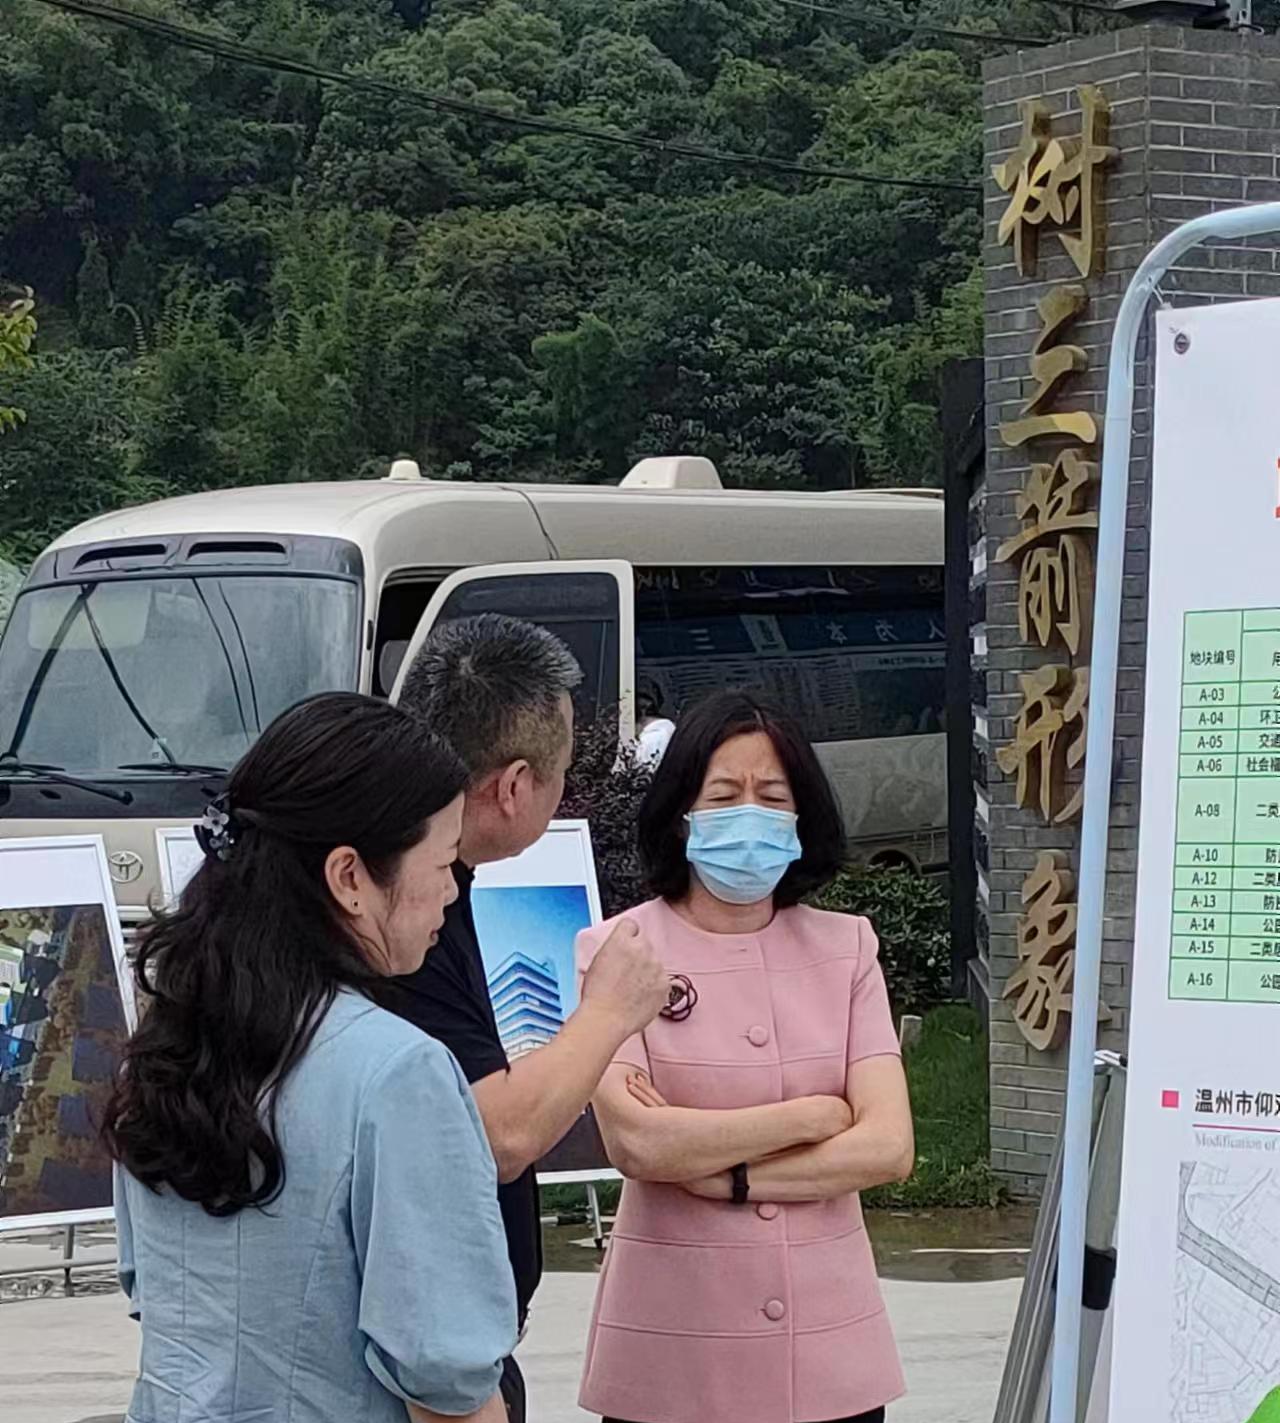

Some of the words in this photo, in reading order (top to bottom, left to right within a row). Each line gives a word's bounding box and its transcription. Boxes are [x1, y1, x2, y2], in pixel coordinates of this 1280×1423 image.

[1190, 650, 1236, 666] 地块编号
[1199, 687, 1225, 702] A-03
[1198, 711, 1224, 726] A-04
[1197, 735, 1223, 749] A-05
[1196, 758, 1222, 772] A-06
[1194, 803, 1220, 818] A-08
[1256, 802, 1280, 818] 二类
[1192, 848, 1218, 862] A-10
[1265, 847, 1280, 863] 防
[1191, 871, 1217, 885] A-12
[1252, 872, 1280, 887] 二类
[1190, 894, 1216, 908] A-13
[1189, 917, 1215, 931] A-14
[1188, 940, 1214, 954] A-15
[1187, 972, 1213, 986] A-16
[1195, 1132, 1262, 1150] Modification
